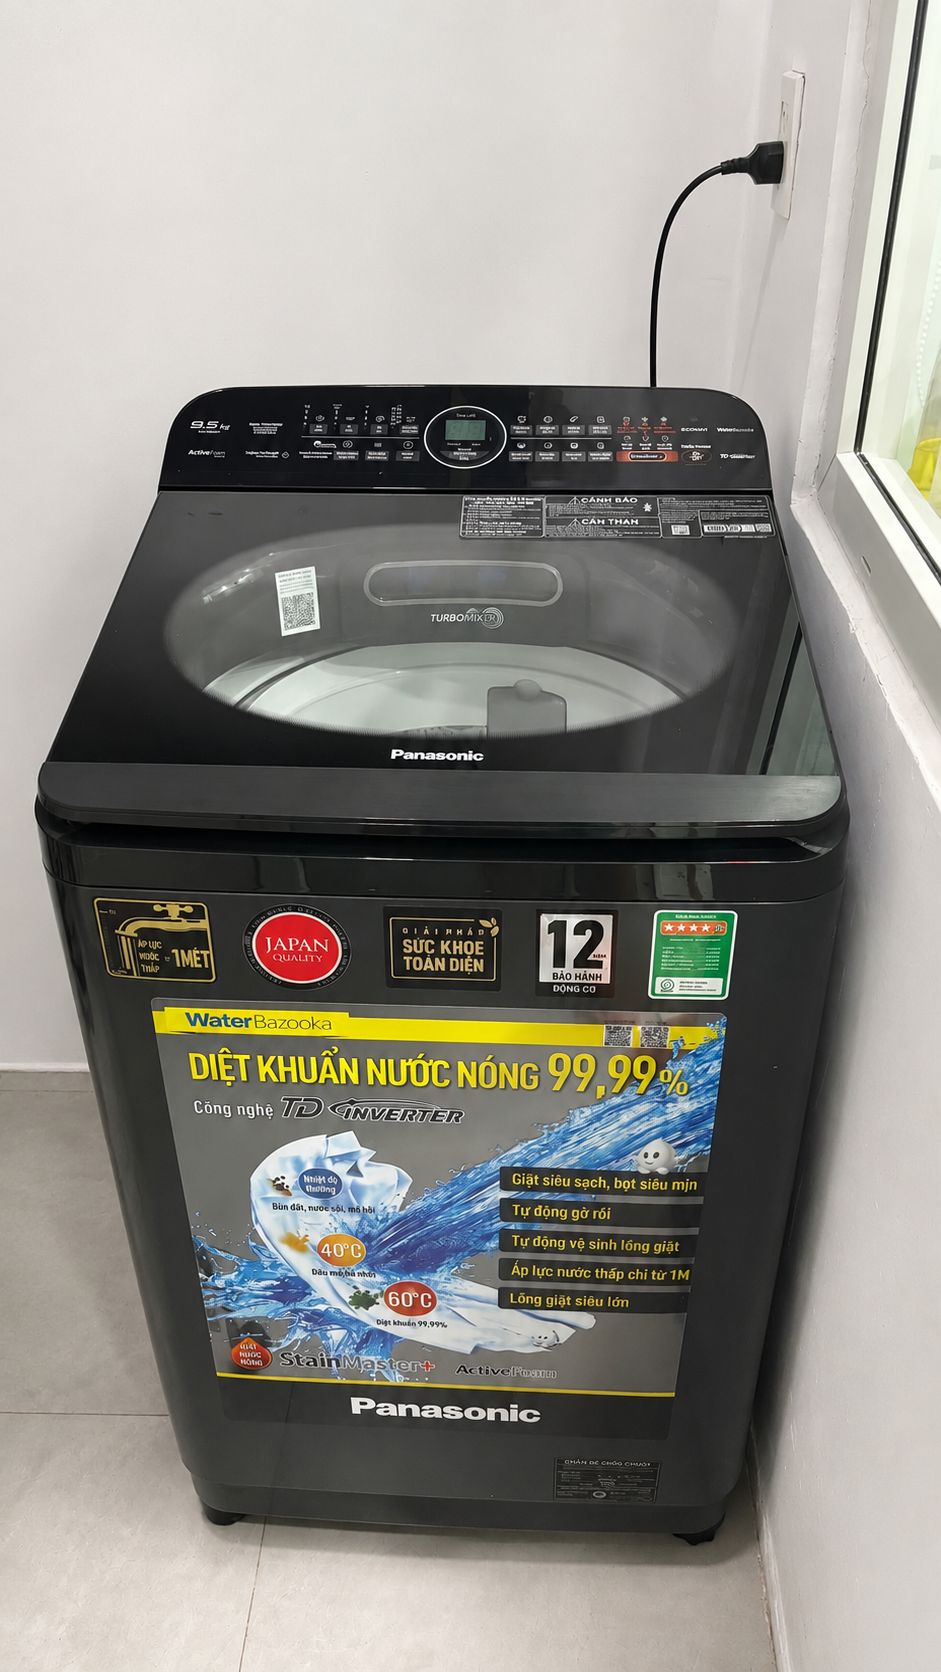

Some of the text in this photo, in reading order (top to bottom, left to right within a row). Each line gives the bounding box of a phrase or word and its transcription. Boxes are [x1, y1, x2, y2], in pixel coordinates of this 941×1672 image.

[190, 421, 219, 429] 9.5
[391, 749, 484, 761] Panasonic
[265, 936, 329, 954] JAPAN
[547, 919, 605, 970] 12
[272, 953, 323, 963] QUALITY
[188, 1047, 251, 1087] DIỆT
[256, 1045, 359, 1085] KHUẨN
[366, 1052, 450, 1088] NƯỚC
[457, 1054, 539, 1090] NÓNG
[236, 1102, 274, 1119] nghệ
[281, 1096, 325, 1119] TD
[341, 1106, 465, 1124] INVERTER
[542, 1174, 570, 1187] siêu
[574, 1176, 611, 1190] sạch,
[614, 1177, 636, 1192] bọt
[640, 1178, 668, 1191] siêu
[671, 1178, 697, 1192] mịn
[512, 1204, 531, 1219] Tự
[534, 1205, 568, 1221] động
[512, 1234, 530, 1249] Tự
[532, 1235, 566, 1251] động
[569, 1238, 585, 1252] vệ
[588, 1238, 617, 1251] sinh
[670, 1269, 691, 1281] 1M
[575, 1296, 604, 1307] siêu
[607, 1297, 629, 1308] lớn
[350, 1396, 541, 1423] Panasonic
